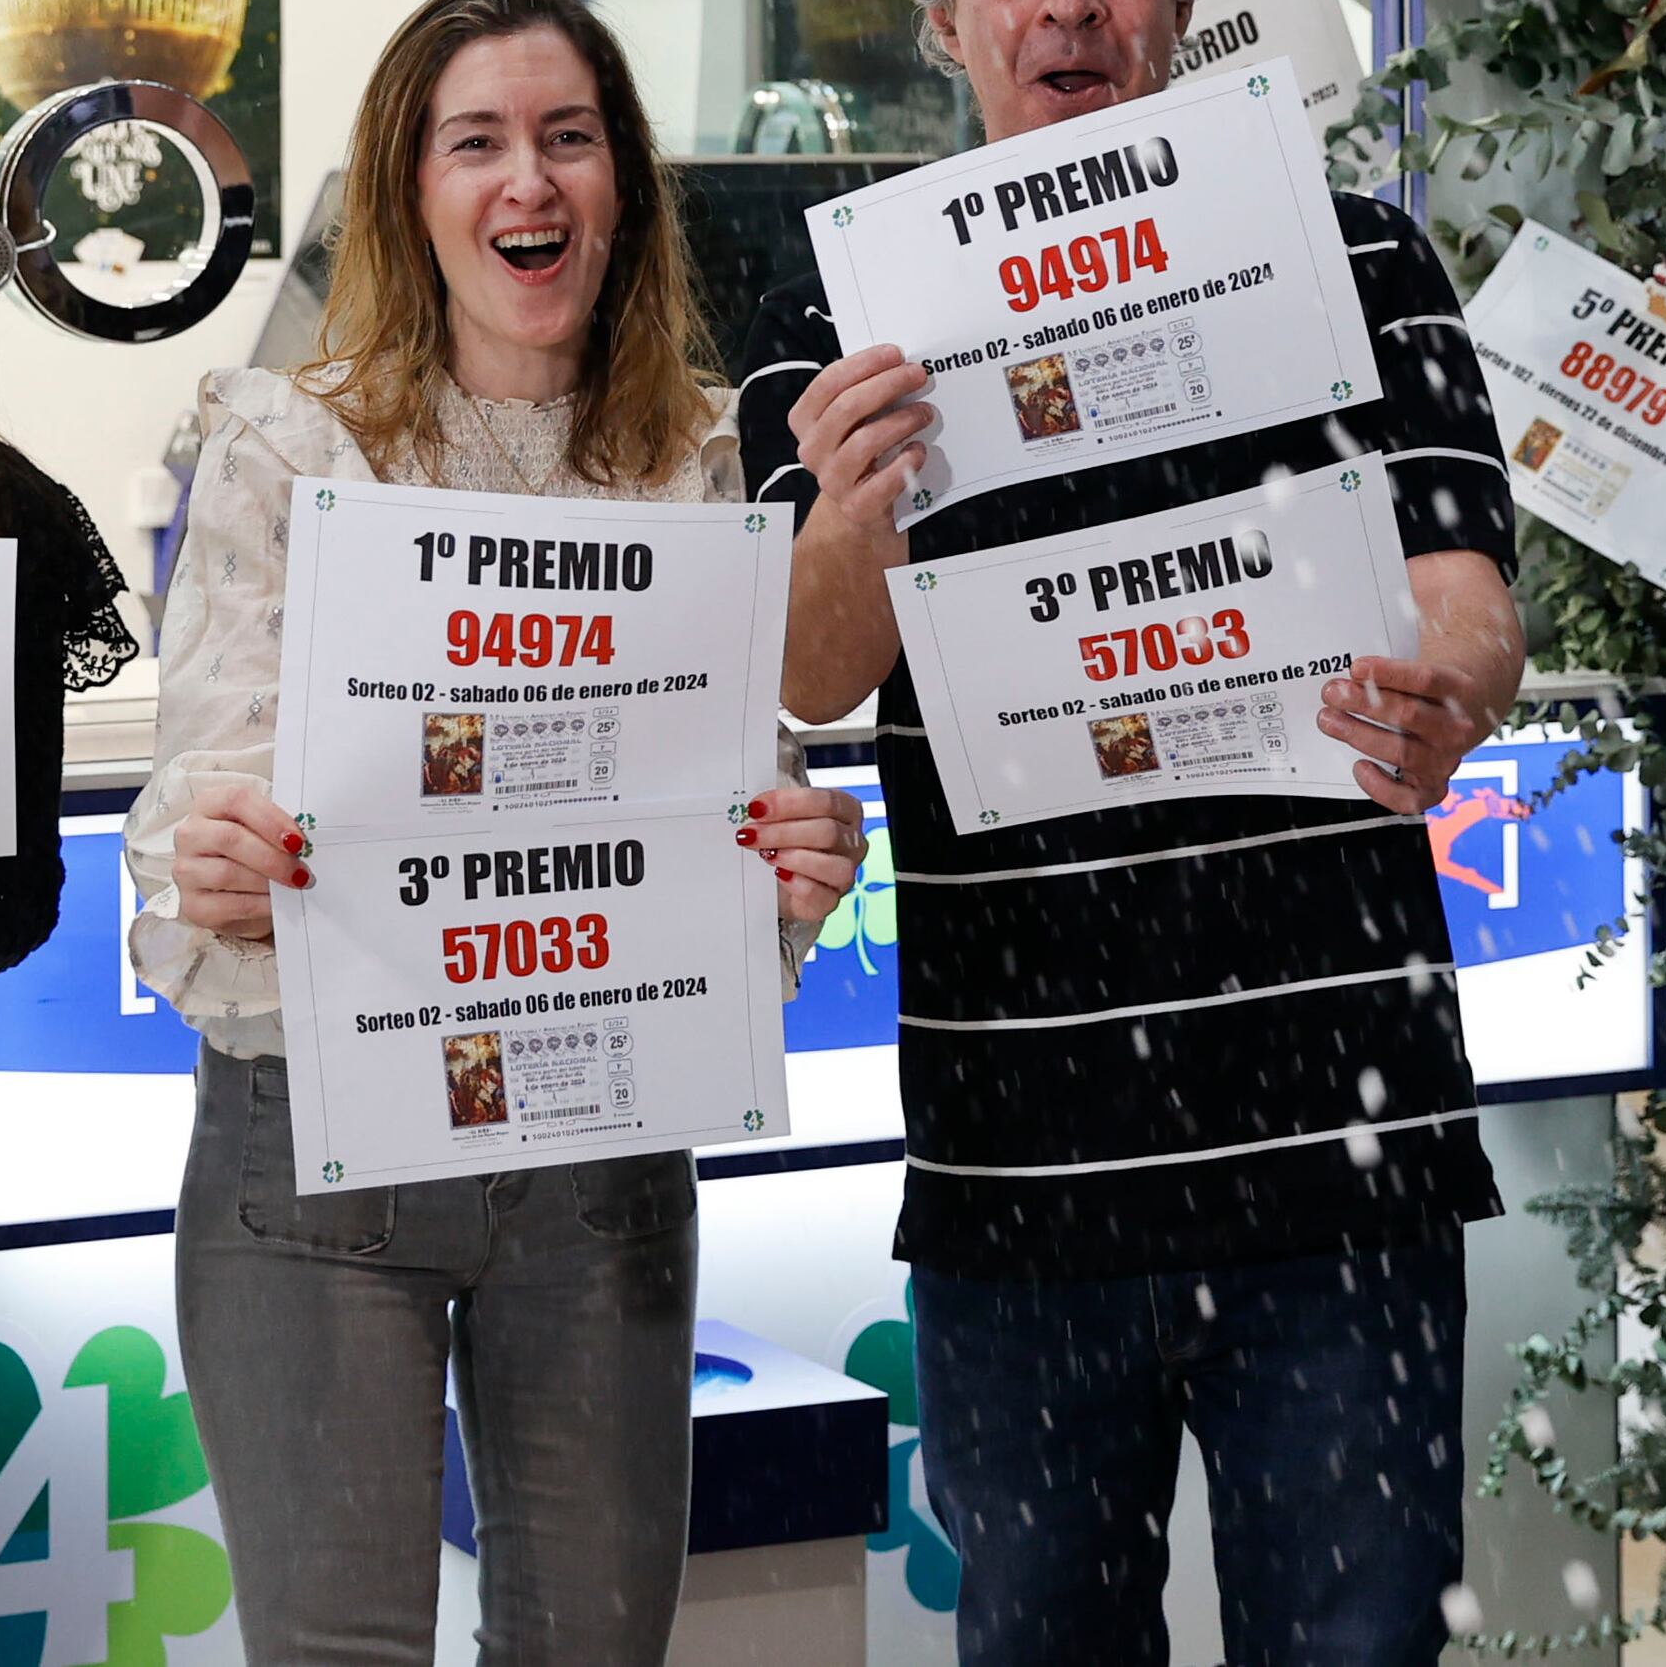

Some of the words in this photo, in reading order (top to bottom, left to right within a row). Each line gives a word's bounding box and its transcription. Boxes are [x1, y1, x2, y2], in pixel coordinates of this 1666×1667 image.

[941, 191, 986, 246] 1º
[996, 135, 1181, 231] PREMIO
[998, 217, 1169, 314] 94974
[1572, 286, 1615, 321] 5º
[412, 531, 457, 583] 1º
[467, 534, 654, 592] PREMIO
[1025, 571, 1077, 624] 3º
[1088, 529, 1275, 612] PREMIO
[445, 609, 615, 668] 94974
[1078, 608, 1251, 683] 57033
[398, 856, 450, 907] 3º
[462, 838, 645, 901] PREMIO
[442, 912, 610, 986] 57033
